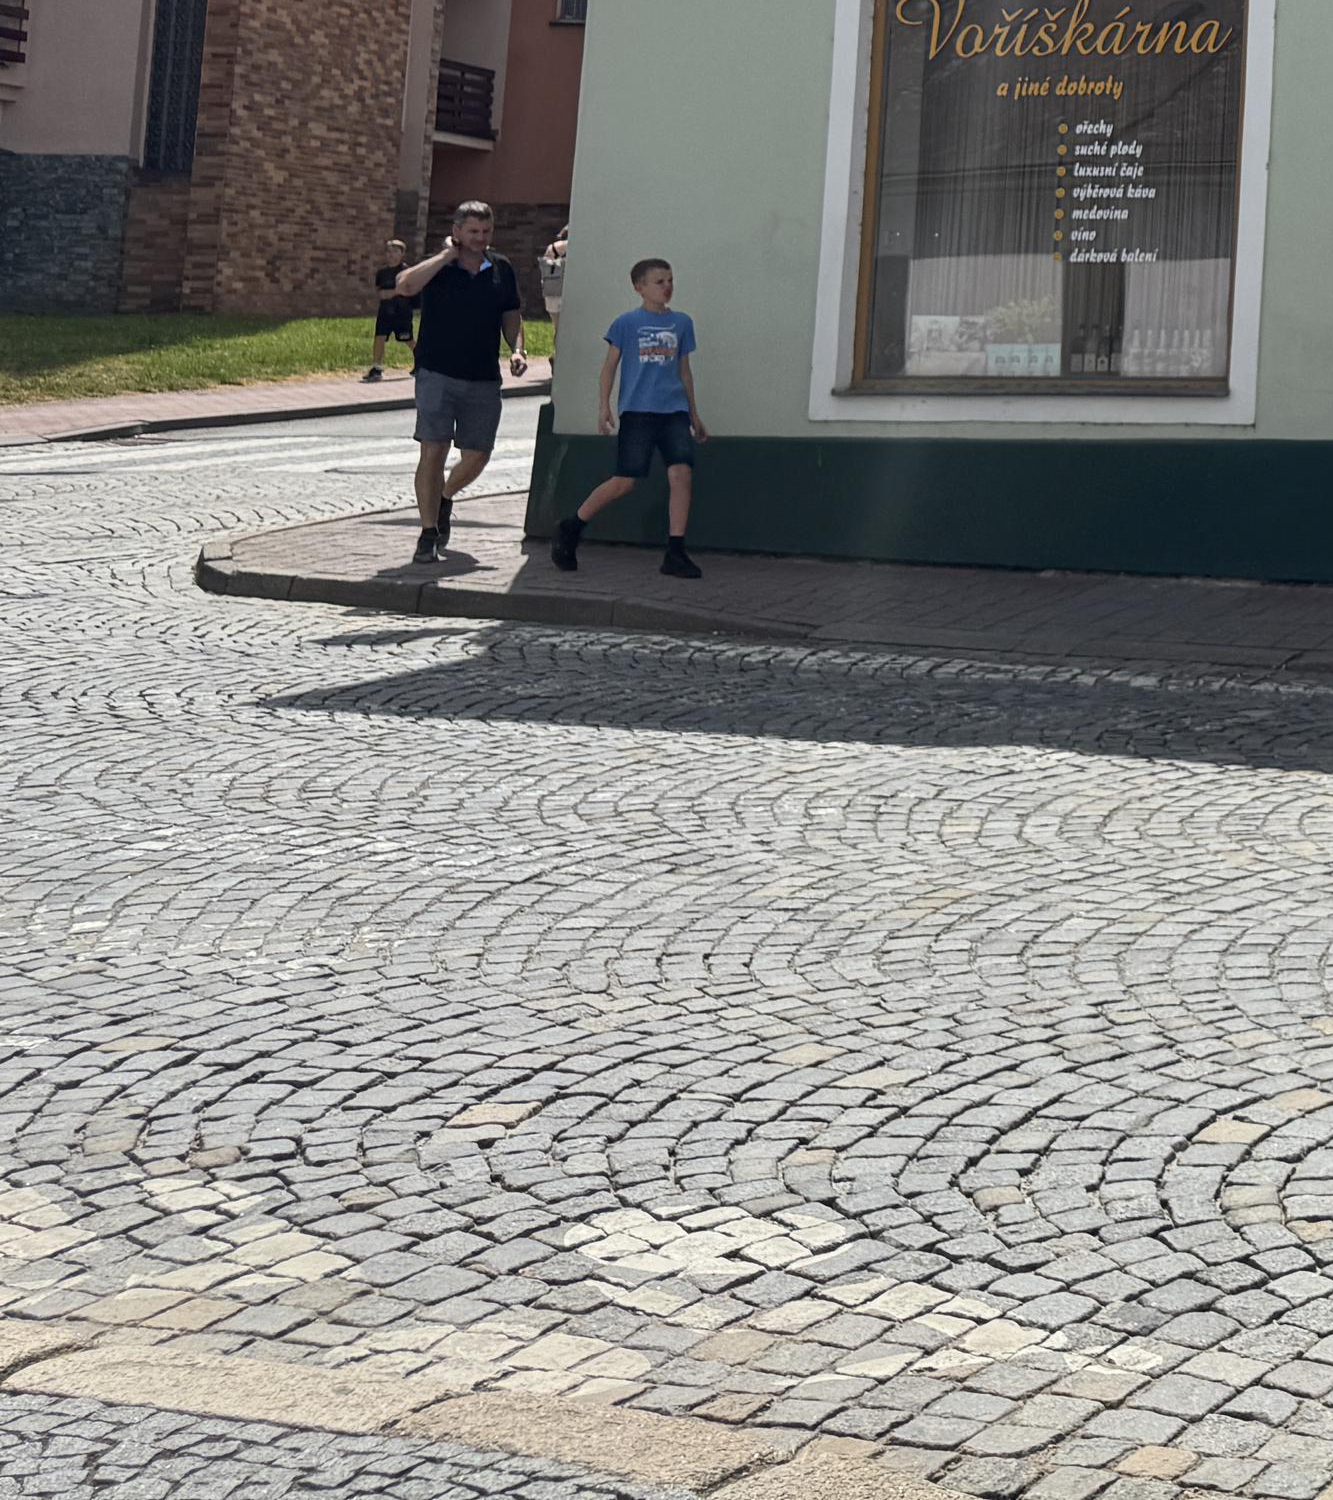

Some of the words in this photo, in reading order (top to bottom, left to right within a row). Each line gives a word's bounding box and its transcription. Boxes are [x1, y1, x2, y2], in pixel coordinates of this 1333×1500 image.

[996, 81, 1009, 96] a
[1014, 77, 1051, 100] jiné
[1055, 75, 1123, 100] dobroty
[1075, 119, 1114, 137] ořechy
[1074, 141, 1108, 155] suché
[1109, 140, 1143, 158] plody
[1073, 162, 1119, 177] luxusní
[1120, 162, 1144, 179] čaje
[1072, 183, 1124, 201] výběrová
[1127, 184, 1156, 198] káva
[1072, 205, 1129, 220] medovina
[1071, 227, 1097, 241] víno
[1069, 248, 1118, 263] dárková
[1121, 248, 1159, 263] balení
